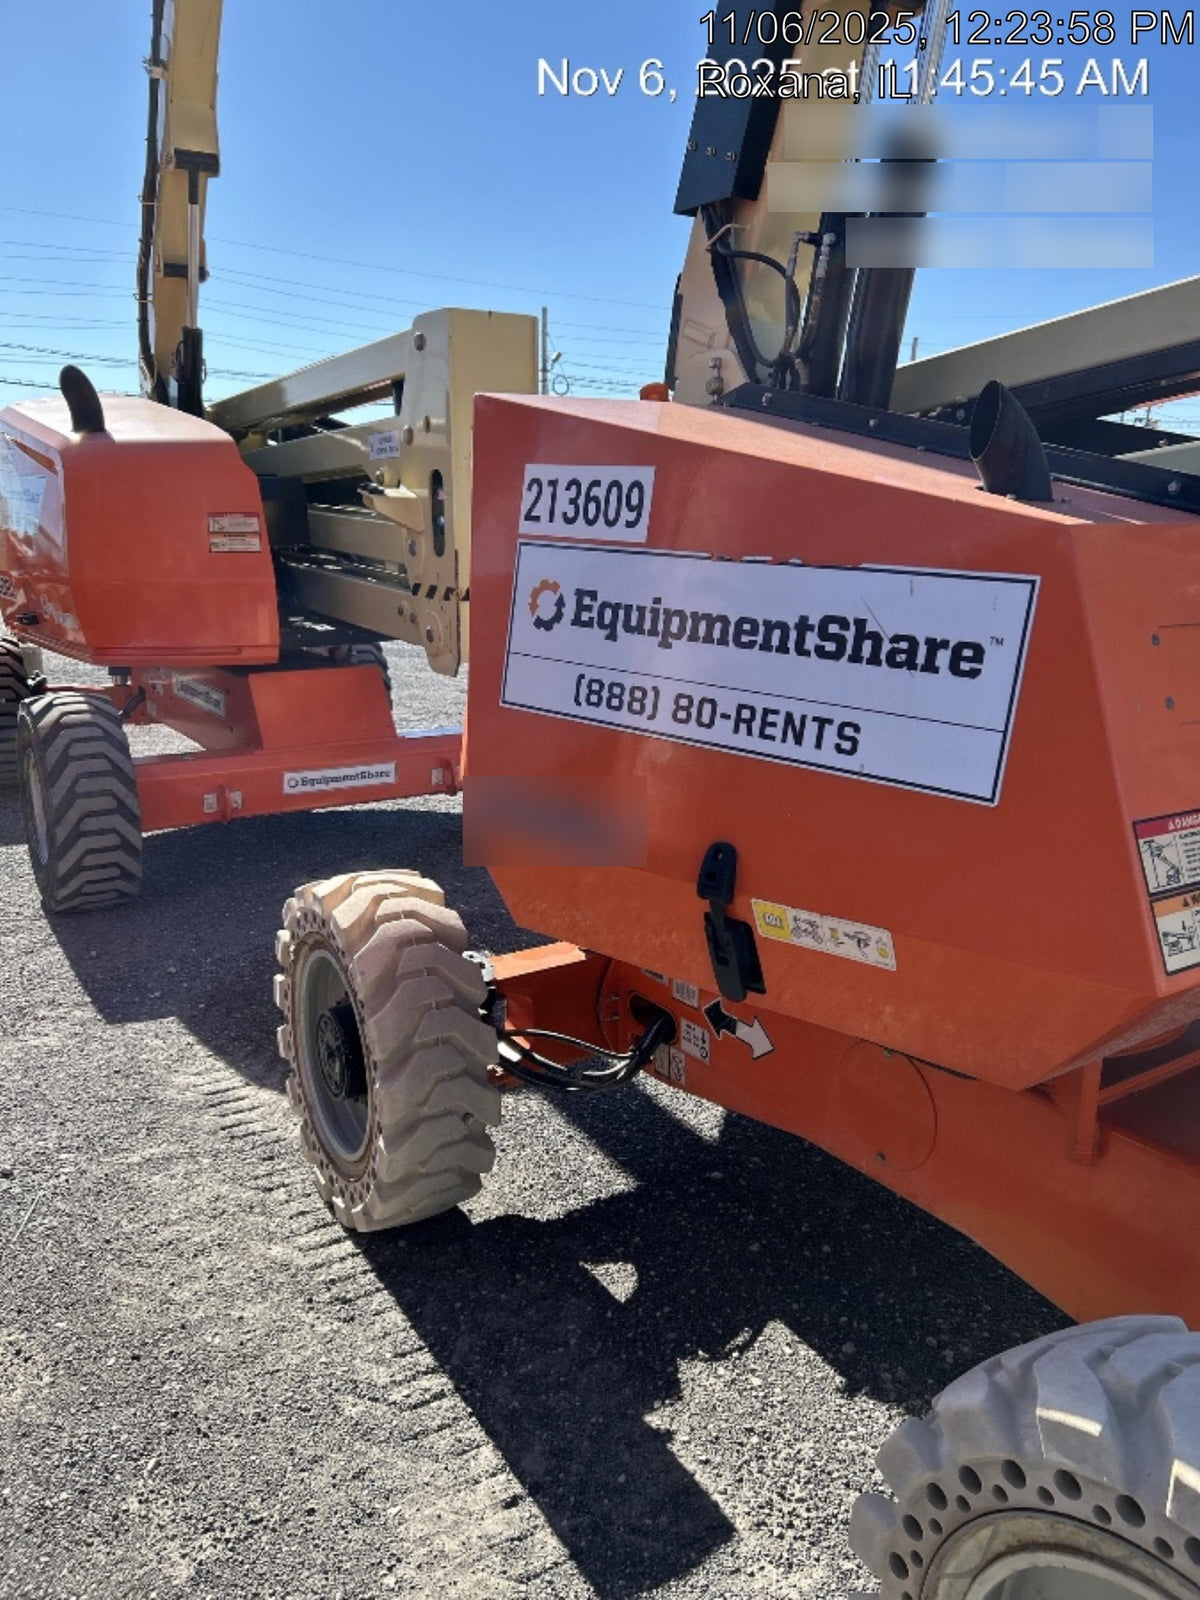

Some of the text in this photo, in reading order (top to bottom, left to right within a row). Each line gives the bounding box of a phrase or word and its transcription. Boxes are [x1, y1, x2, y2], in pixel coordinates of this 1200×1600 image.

[523, 477, 645, 530] 213609
[570, 588, 986, 680] EquipmentShare
[573, 673, 862, 757] (888) 80-RENTS
